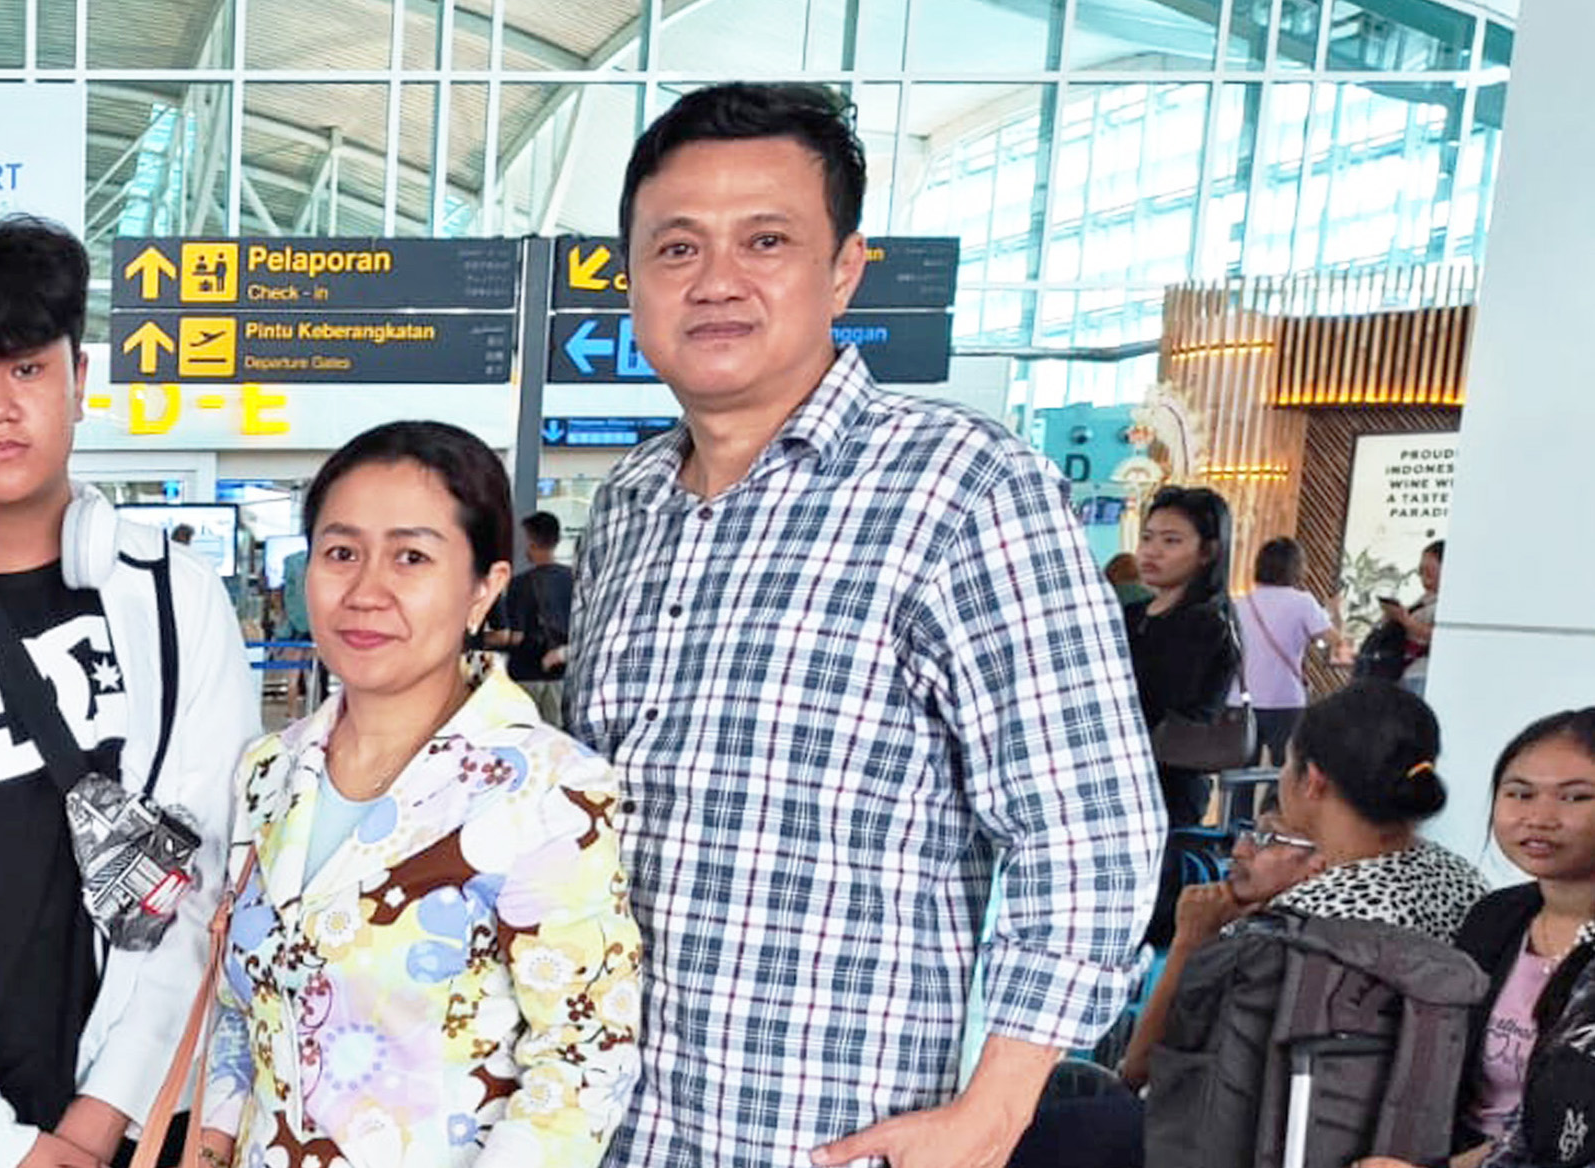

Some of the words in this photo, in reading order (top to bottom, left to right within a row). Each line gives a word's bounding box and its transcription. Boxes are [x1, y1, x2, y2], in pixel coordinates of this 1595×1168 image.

[247, 245, 392, 278] Pelaporan
[246, 284, 300, 300] Check
[244, 321, 294, 341] Pintu
[297, 321, 436, 345] Keberangkatan
[829, 327, 887, 345] nggan
[1400, 449, 1456, 460] PROUD
[1389, 479, 1429, 489] WINE
[1386, 493, 1396, 503] A
[1402, 492, 1449, 504] TASTE
